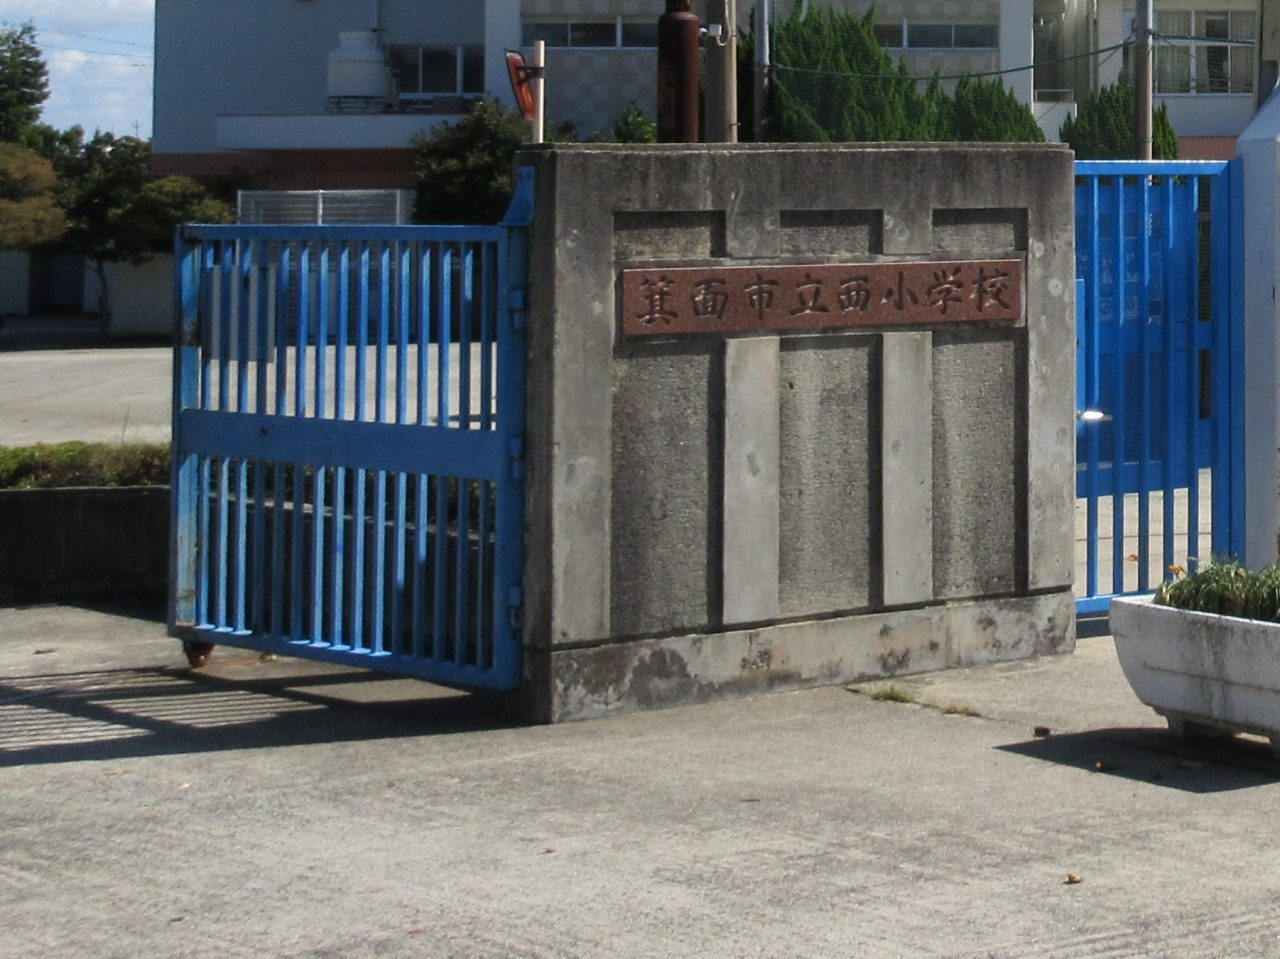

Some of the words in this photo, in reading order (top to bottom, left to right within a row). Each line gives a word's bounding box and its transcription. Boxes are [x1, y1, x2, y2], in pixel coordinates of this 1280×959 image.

[637, 266, 1011, 326] 箕面市立西小学校
